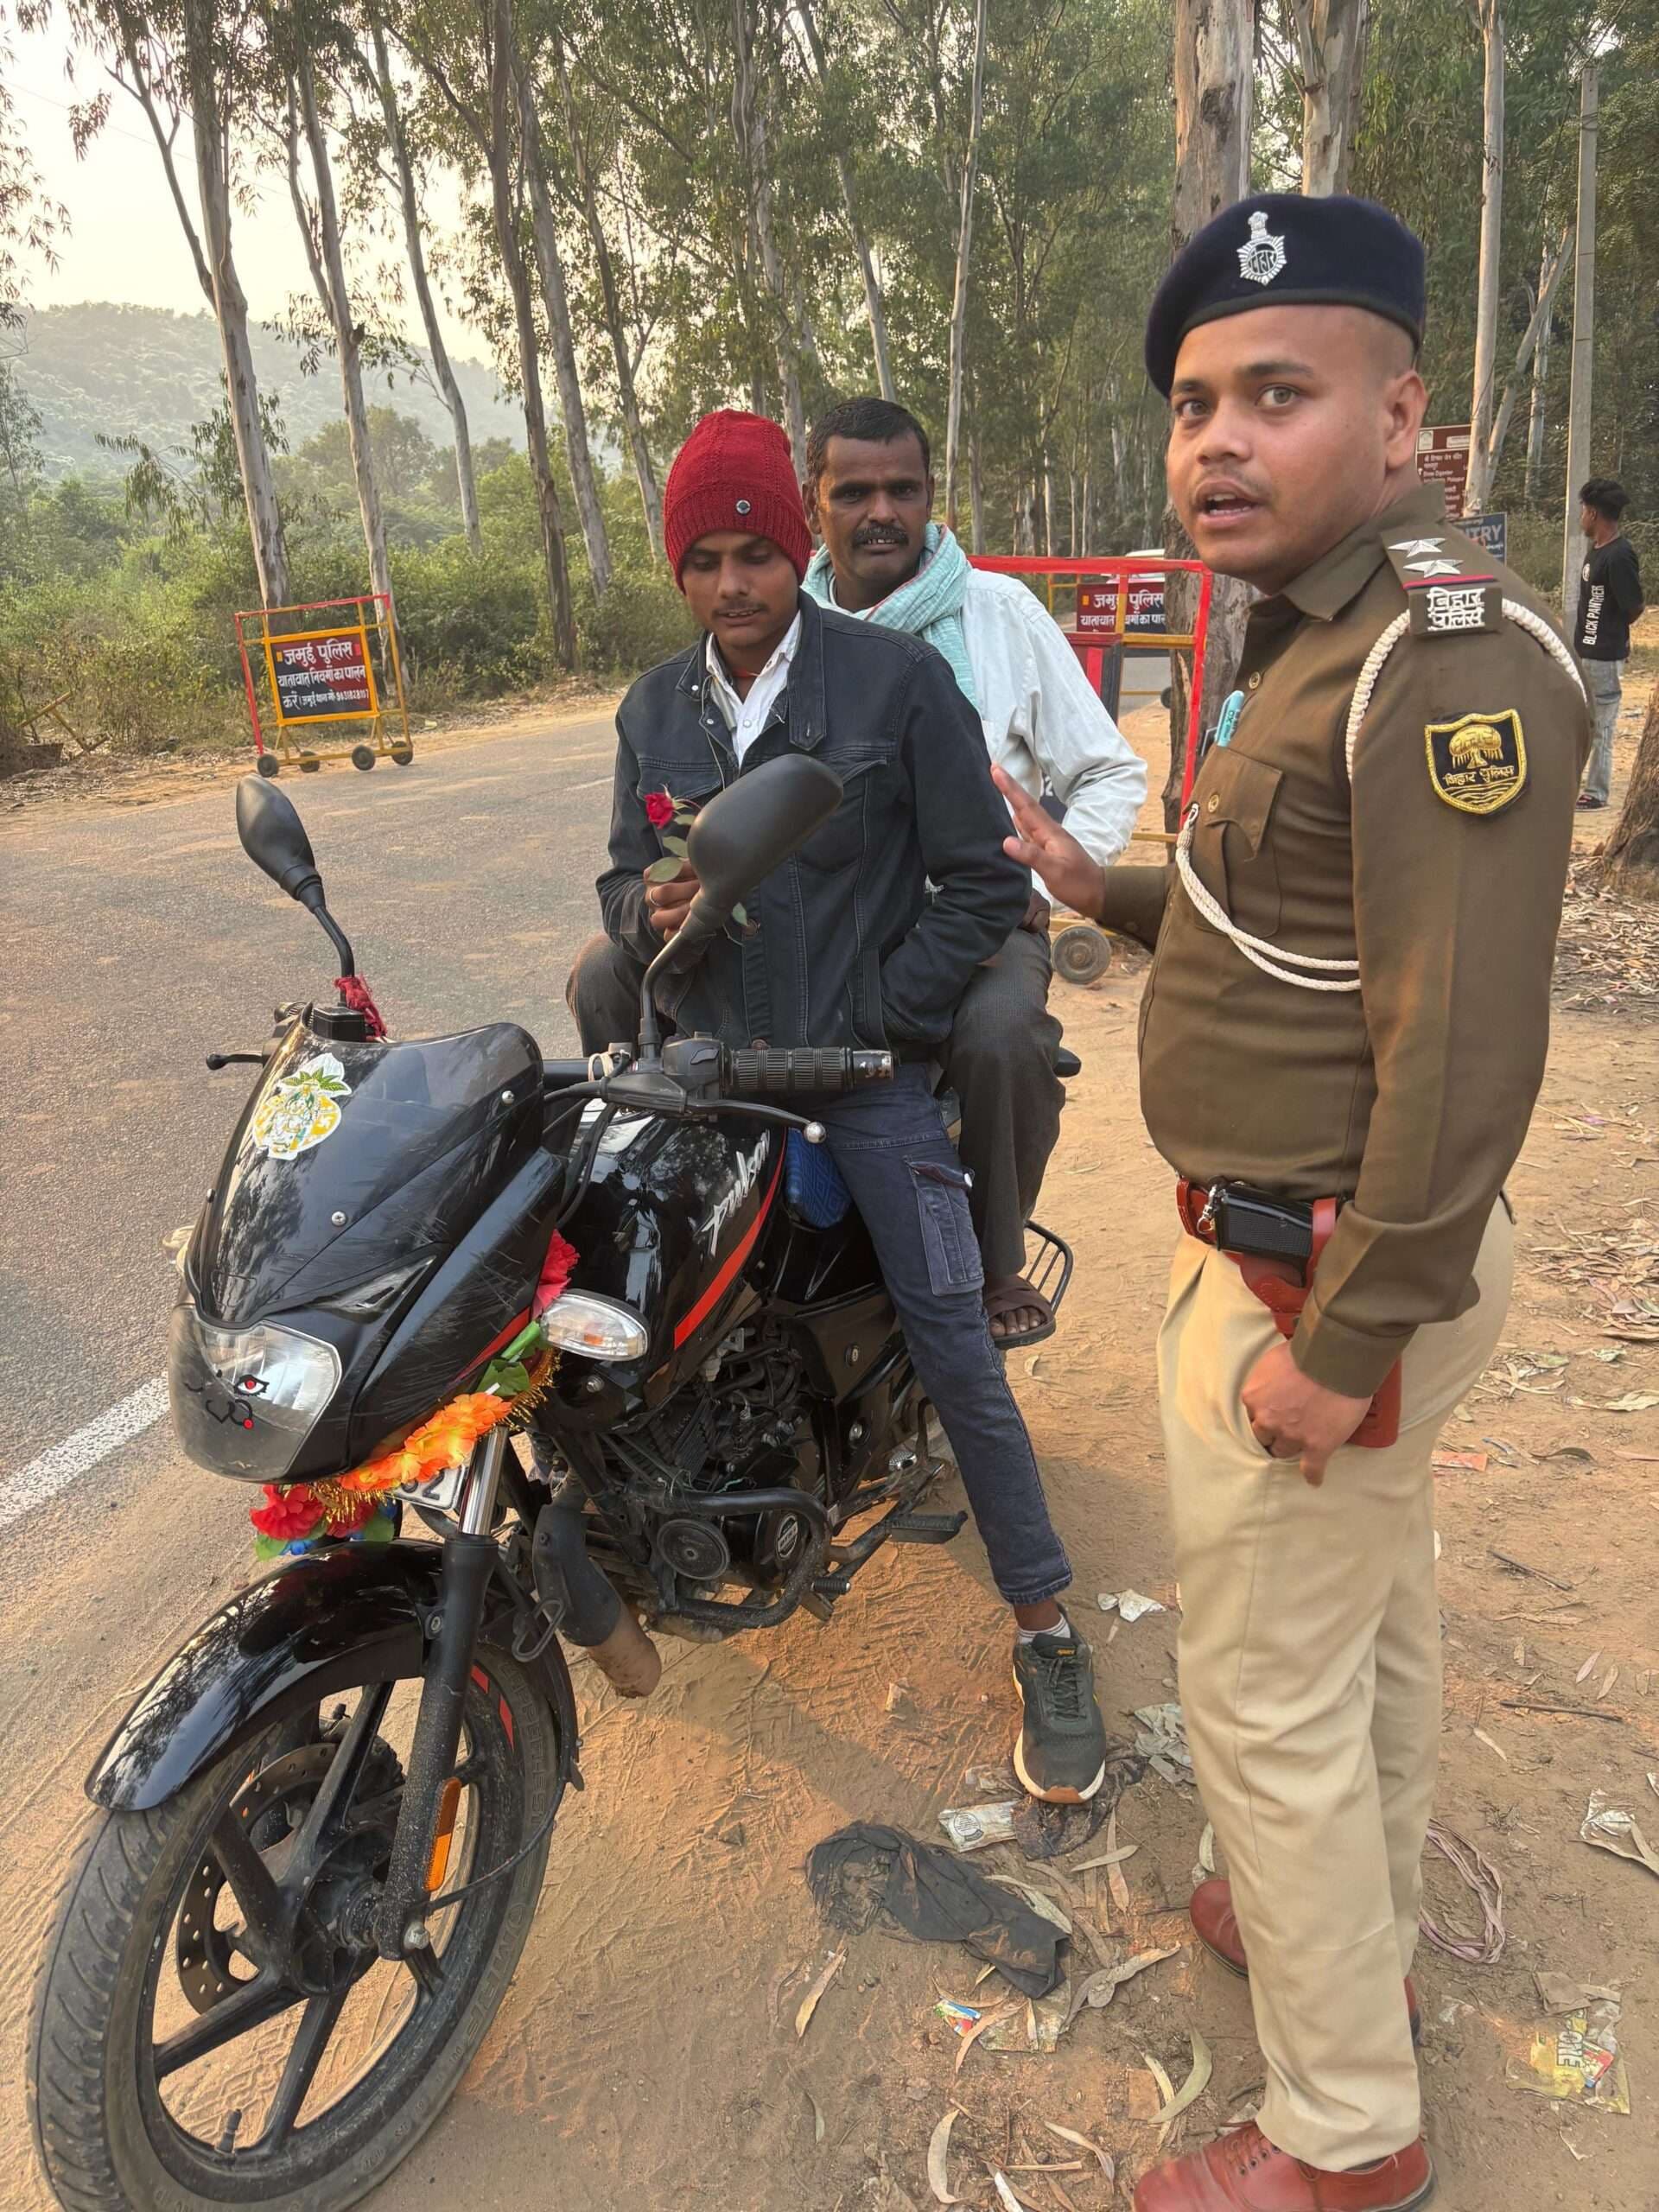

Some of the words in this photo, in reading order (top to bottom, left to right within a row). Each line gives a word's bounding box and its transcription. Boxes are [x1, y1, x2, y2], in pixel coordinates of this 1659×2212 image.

[1128, 589, 1164, 610] पुलिस
[1427, 587, 1485, 607] बिहार
[1586, 585, 1605, 620] PANTHER
[1582, 618, 1599, 645] BLACK
[283, 642, 316, 667] जमुई
[317, 639, 353, 664] पुलिस
[277, 671, 310, 688] यातायात
[334, 668, 345, 680] का
[345, 664, 365, 682] पालन
[1442, 772, 1477, 786] बिहार
[1479, 765, 1514, 783] पुलिस
